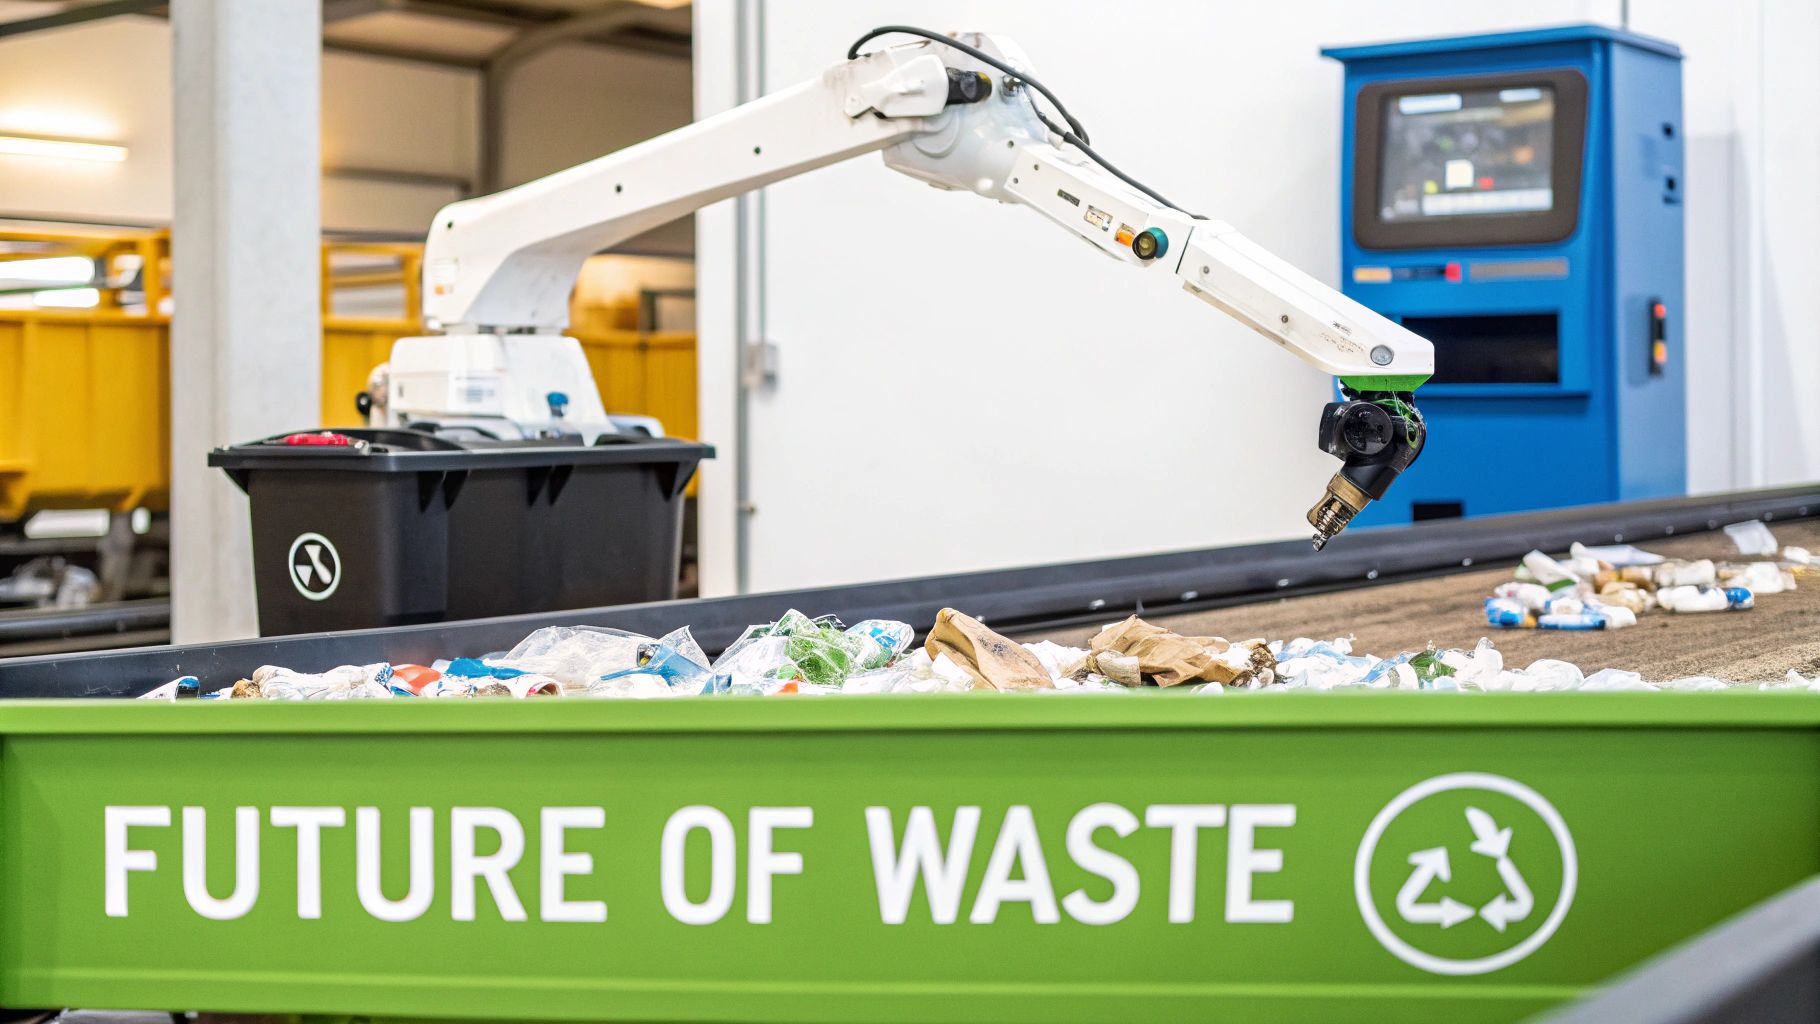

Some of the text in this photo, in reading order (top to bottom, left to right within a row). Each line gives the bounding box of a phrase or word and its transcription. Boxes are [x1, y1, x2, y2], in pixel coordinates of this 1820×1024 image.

[104, 802, 1297, 925] FUTURE OF WASTE
